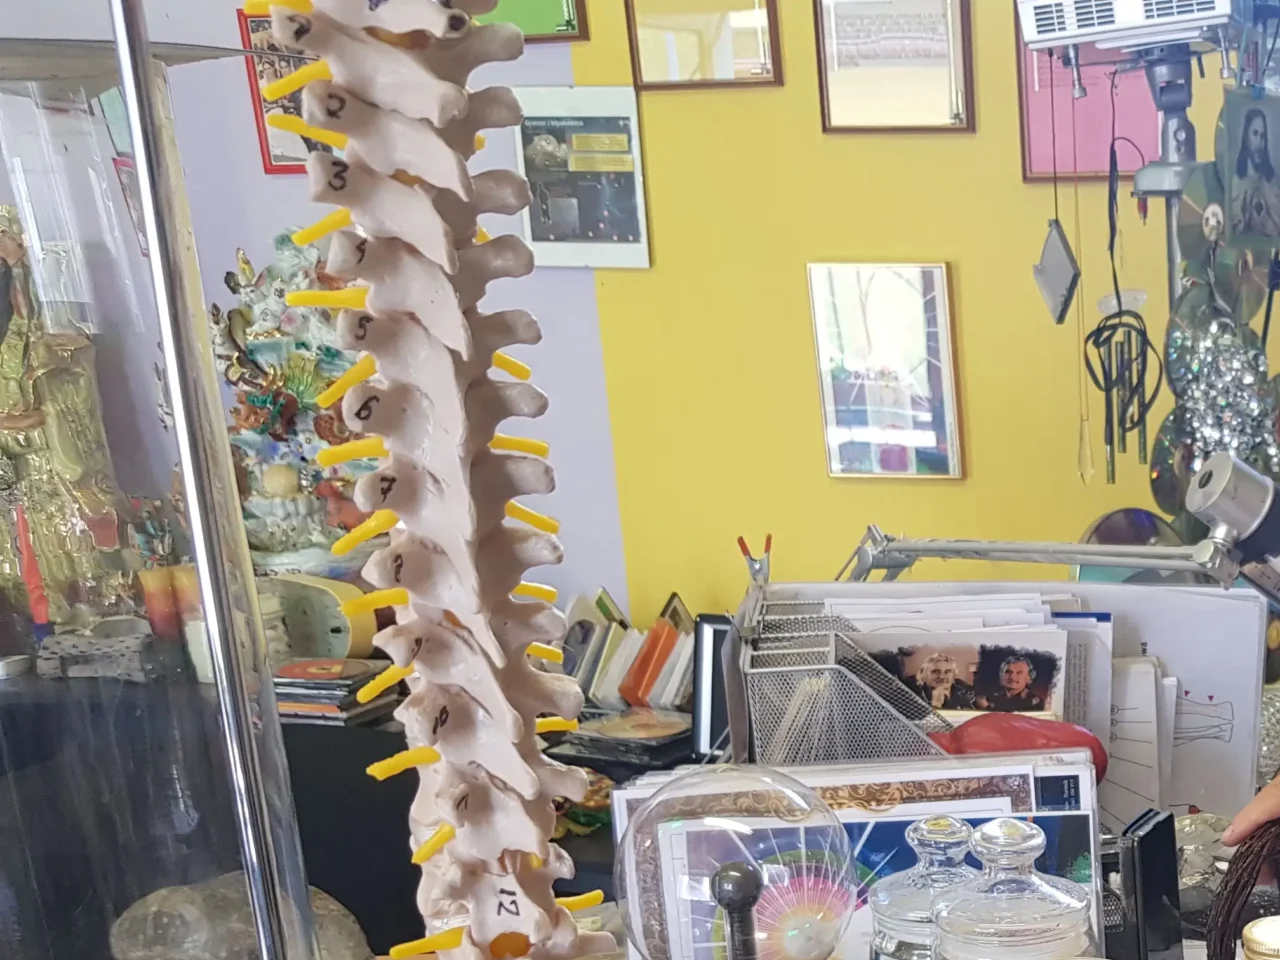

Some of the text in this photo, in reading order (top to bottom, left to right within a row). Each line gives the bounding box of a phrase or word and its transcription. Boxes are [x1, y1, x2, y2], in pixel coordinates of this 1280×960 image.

[328, 161, 349, 192] 3
[355, 315, 374, 341] 5
[354, 395, 379, 421] 6
[496, 887, 521, 919] 12
